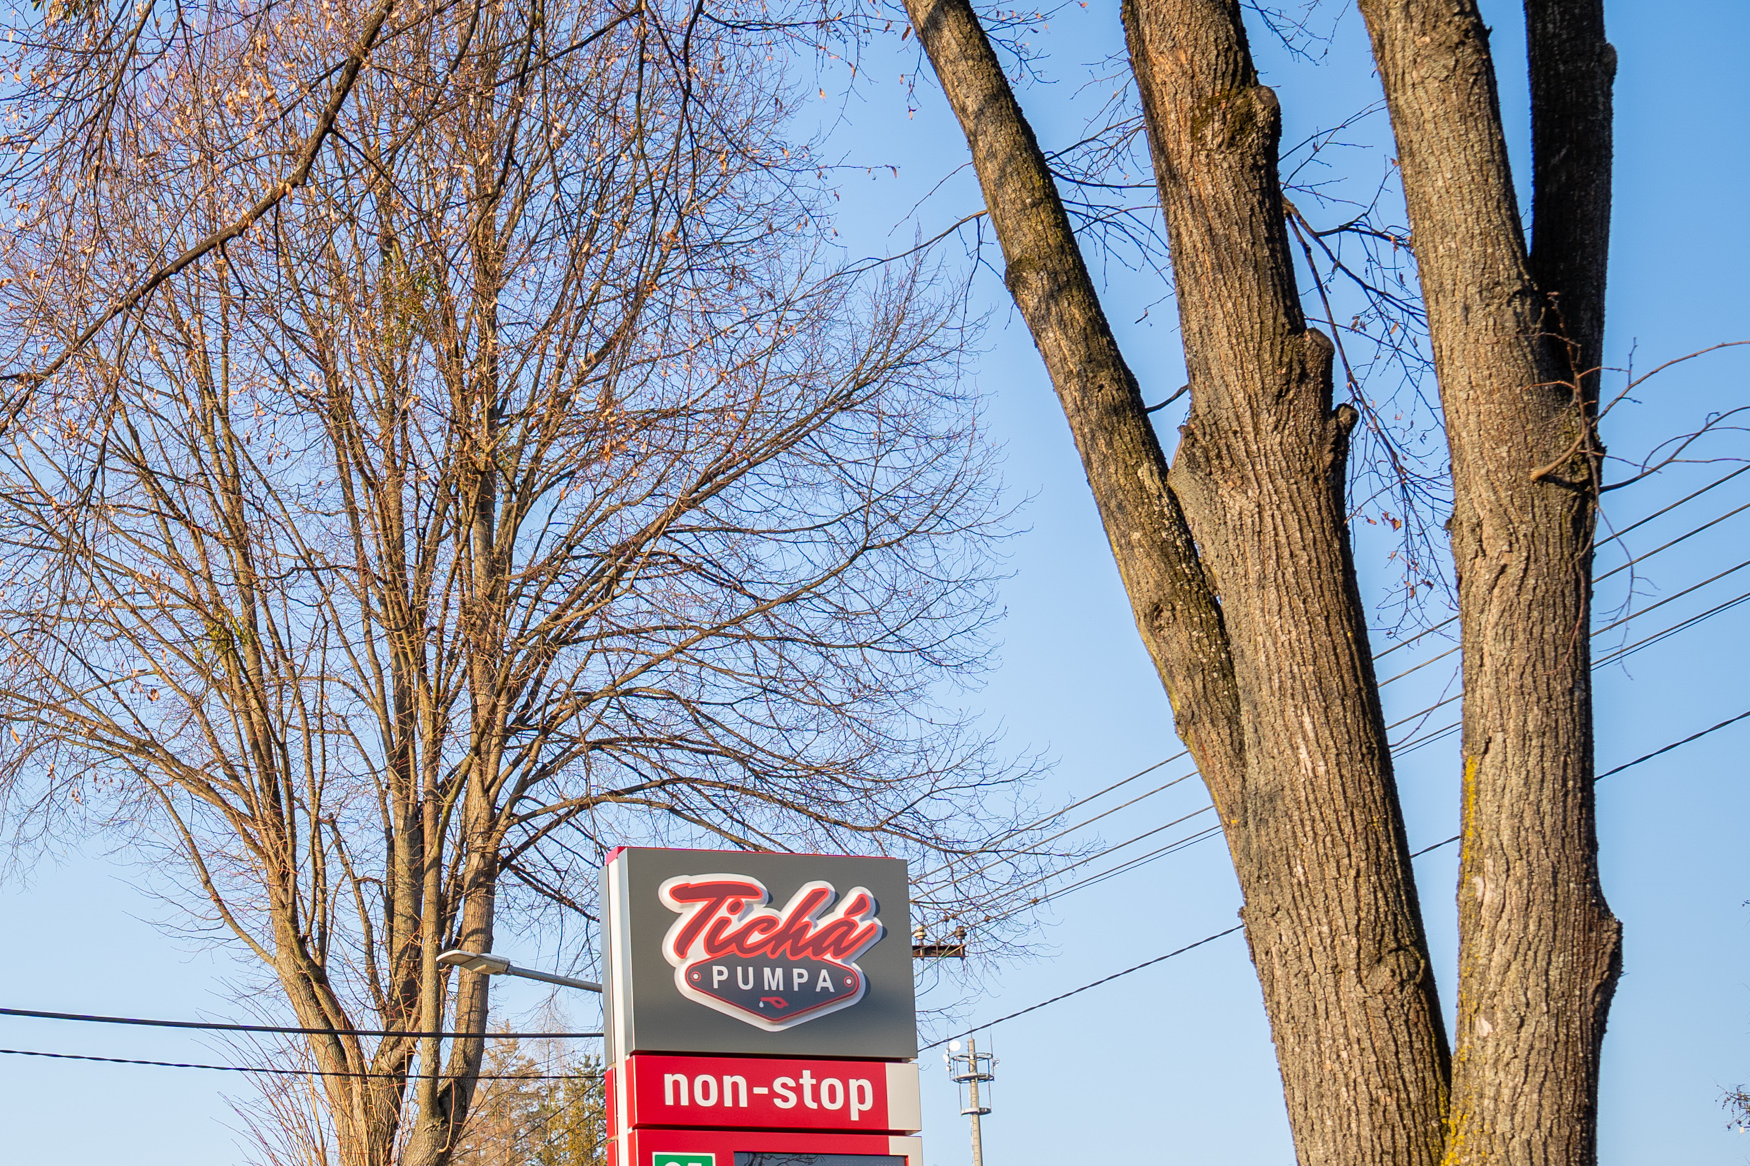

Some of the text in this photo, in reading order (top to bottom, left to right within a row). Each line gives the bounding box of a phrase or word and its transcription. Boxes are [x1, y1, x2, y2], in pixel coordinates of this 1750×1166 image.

[668, 880, 879, 961] Tichá
[712, 963, 836, 994] PUMPA
[663, 1069, 874, 1121] non-stop
